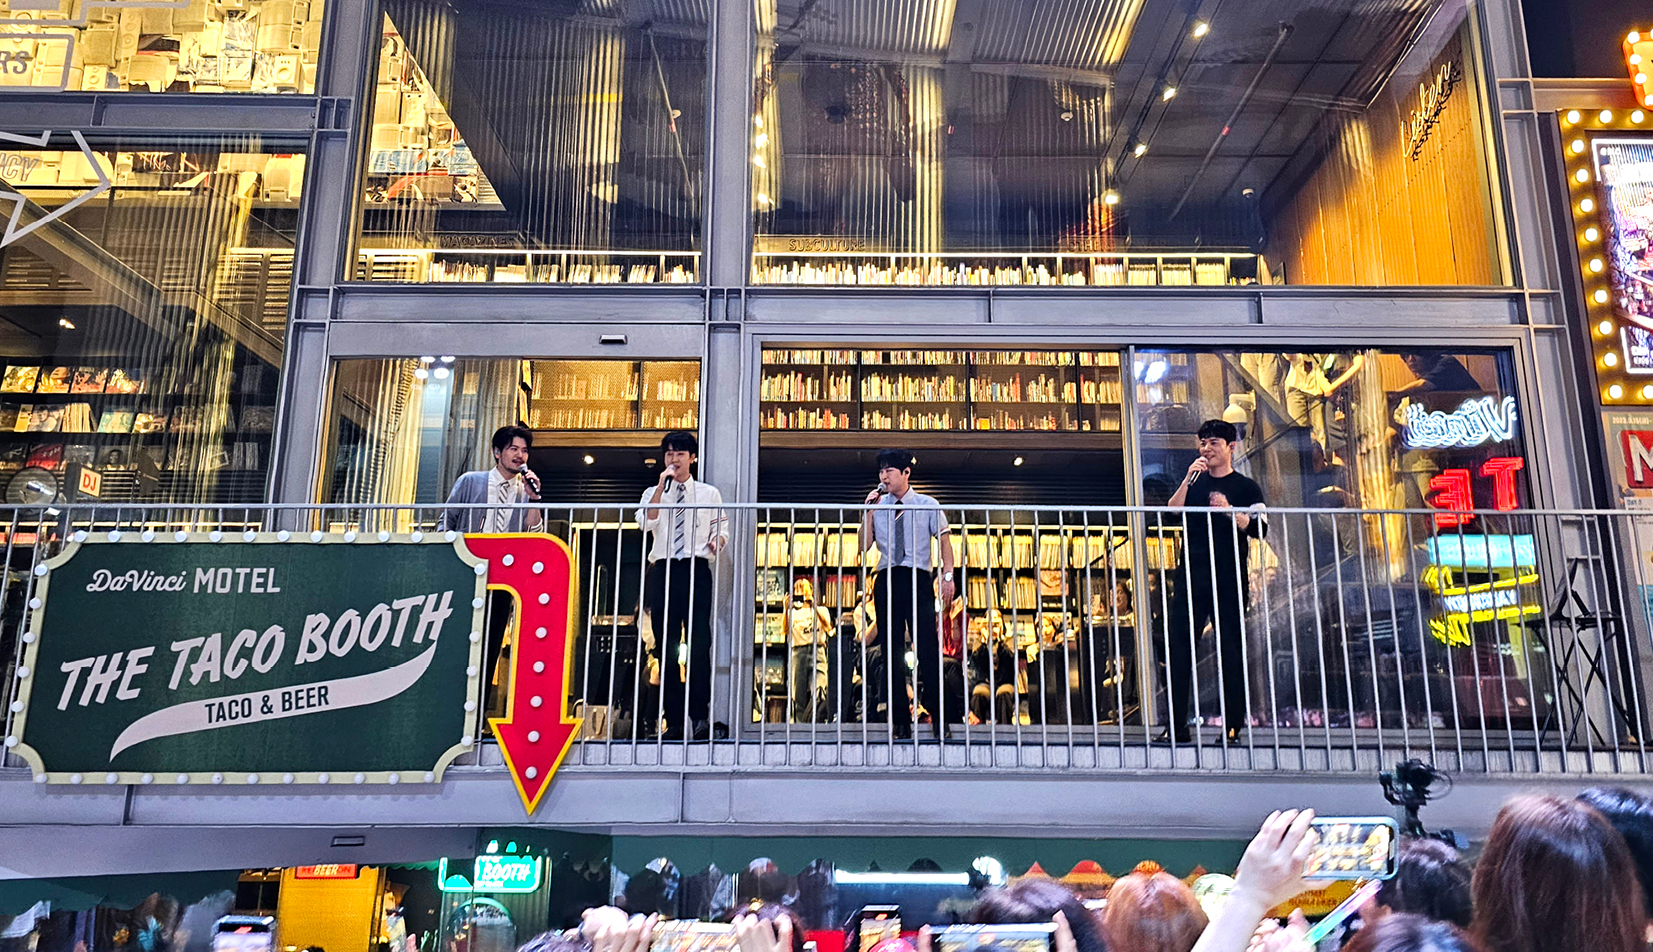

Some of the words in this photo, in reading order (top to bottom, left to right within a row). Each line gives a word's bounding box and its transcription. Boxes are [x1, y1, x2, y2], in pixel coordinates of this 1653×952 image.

[789, 239, 866, 252] SUBCULTURE
[83, 473, 97, 491] DJ
[86, 568, 187, 592] DaVinci
[193, 567, 281, 594] MOTEL
[57, 646, 155, 711] THE
[168, 624, 286, 690] TACO
[294, 590, 454, 665] BOOTH
[205, 698, 252, 723] TACO
[260, 695, 273, 714] &
[281, 685, 329, 712] BEER
[314, 864, 339, 876] BEER
[482, 862, 532, 881] BOOTH
